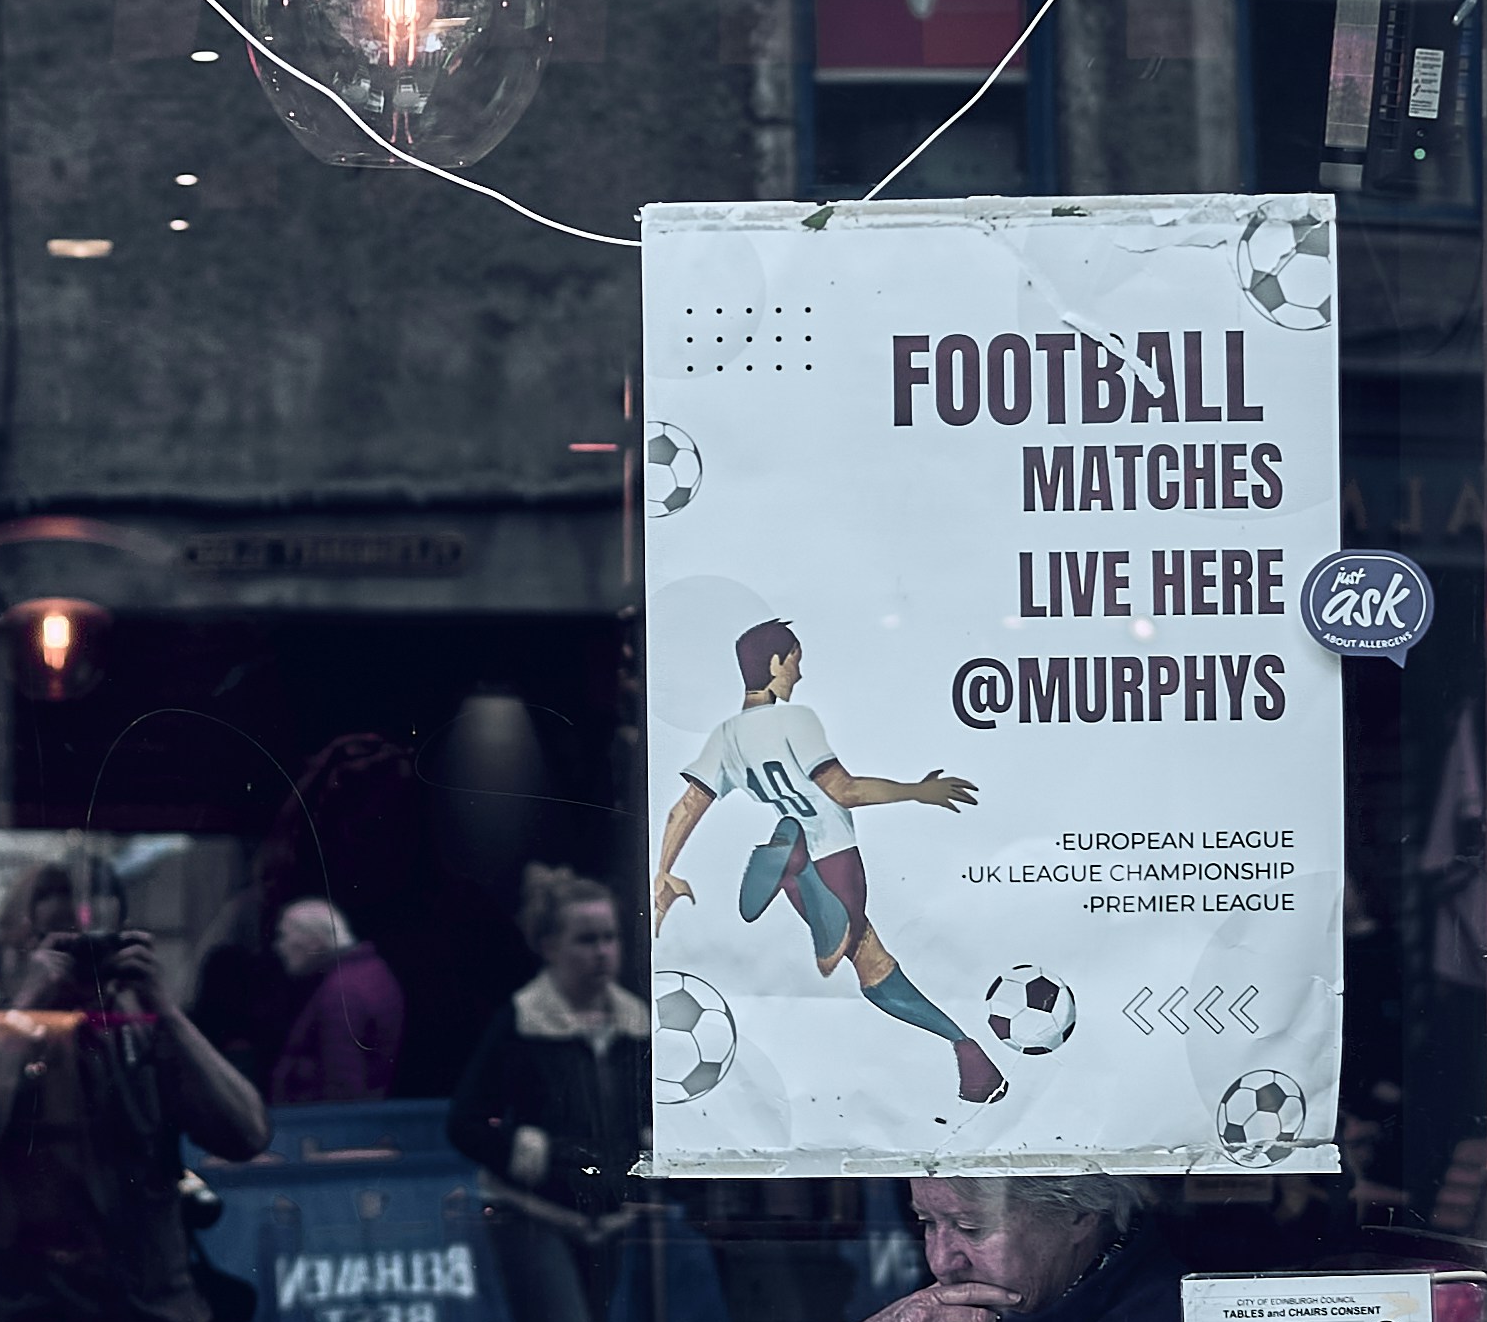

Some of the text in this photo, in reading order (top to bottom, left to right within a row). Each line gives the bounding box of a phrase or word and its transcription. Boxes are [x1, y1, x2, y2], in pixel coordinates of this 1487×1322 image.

[892, 329, 1264, 427] FOOTBALL
[1022, 442, 1284, 512] MATCHES
[1018, 548, 1285, 618] LIVE HERE
[1331, 567, 1367, 592] just
[1321, 573, 1411, 629] ask
[1322, 631, 1414, 650] ABOUT ALLERGENS
[951, 653, 1286, 730] @MURPHYS
[1061, 830, 1295, 851] EUROPEAN LEAGUE
[968, 862, 1295, 884] UK LEAGUE CHAMPIONSHIP
[1089, 893, 1295, 914] PREMIER LEAGUE
[1223, 1306, 1381, 1319] TABLES and CHAIRS CONSENT
[1237, 1296, 1356, 1306] CITY OF EDINBURGH COUNCIL
